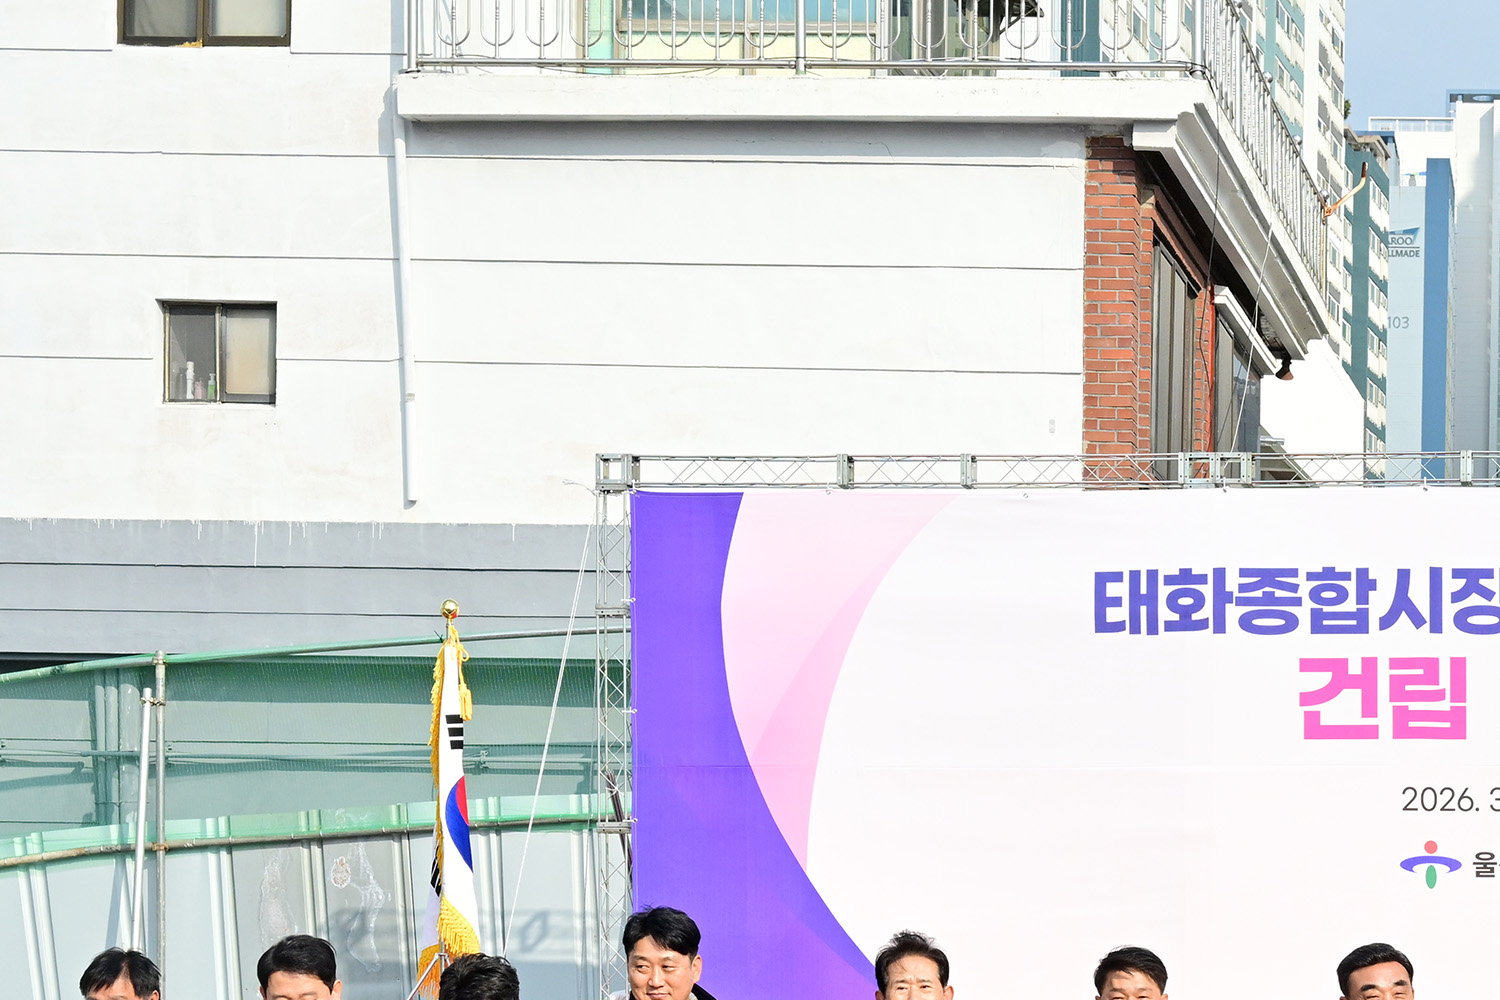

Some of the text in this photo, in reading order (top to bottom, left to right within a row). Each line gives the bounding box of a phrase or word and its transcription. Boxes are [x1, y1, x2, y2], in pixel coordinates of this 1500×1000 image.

[1388, 236, 1413, 246] ROO
[1387, 316, 1410, 329] 103
[1299, 656, 1467, 740] 건립
[1402, 787, 1480, 812] 2026.
